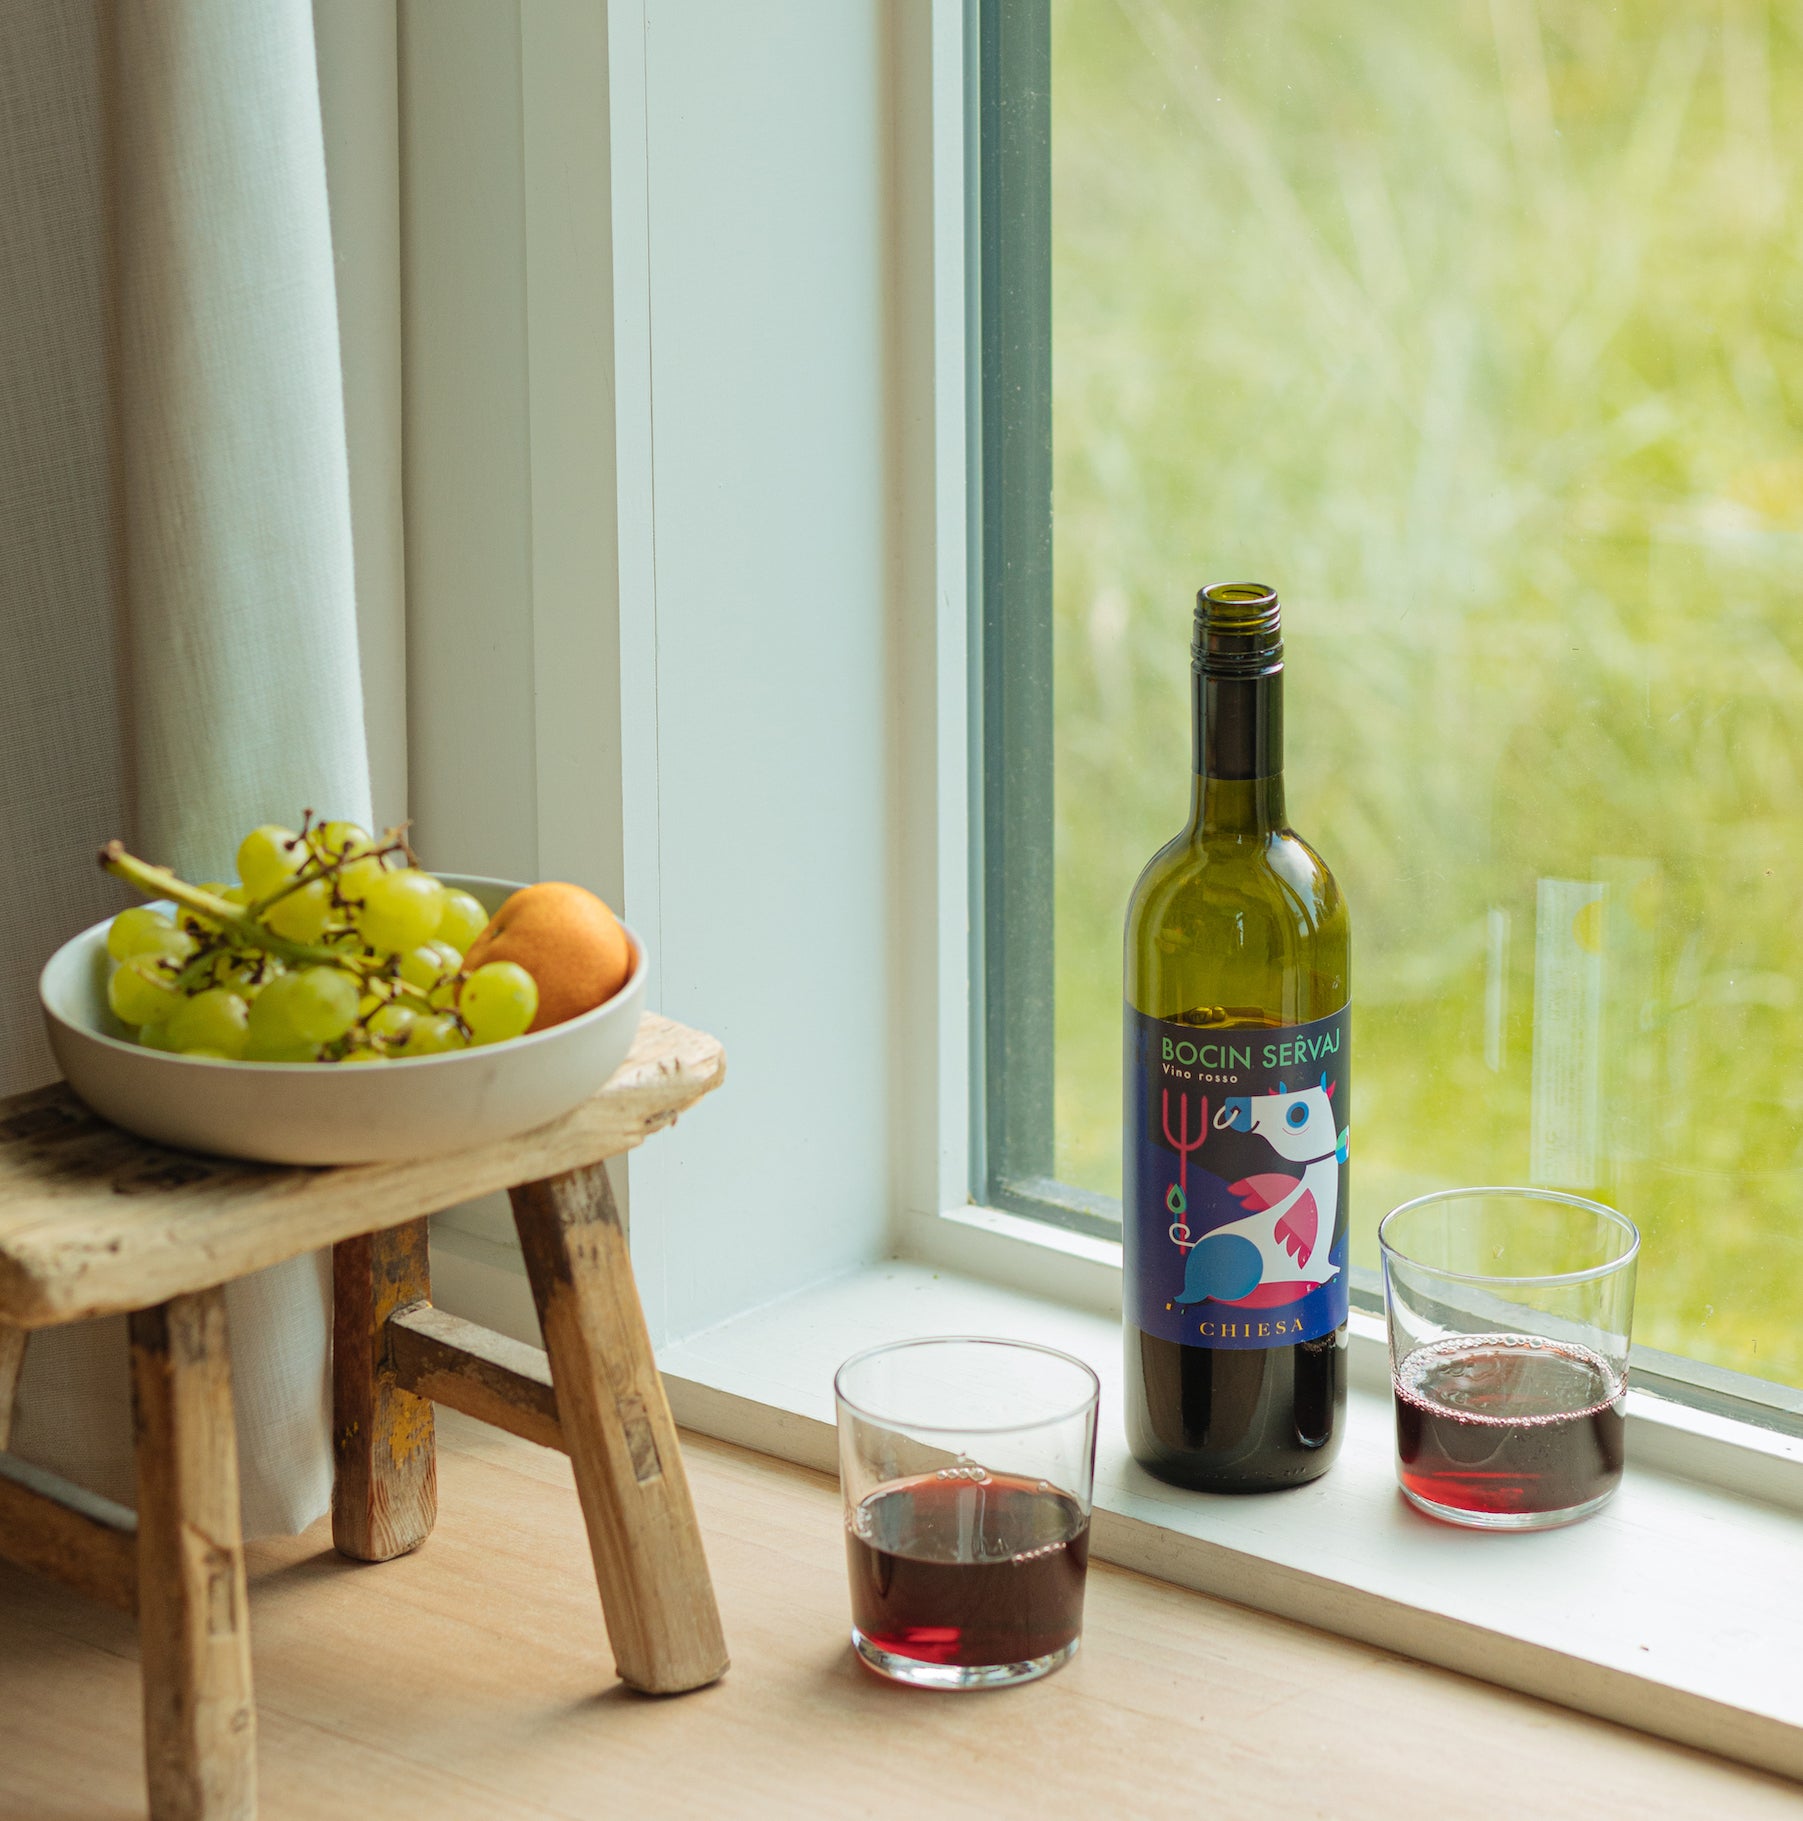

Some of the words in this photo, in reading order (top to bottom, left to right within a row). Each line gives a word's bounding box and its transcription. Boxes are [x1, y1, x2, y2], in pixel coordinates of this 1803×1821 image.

[1162, 1037, 1250, 1070] BOCIN
[1162, 1063, 1192, 1080] Vino
[1199, 1073, 1238, 1084] rosso
[1199, 1318, 1303, 1337] CHIESA
